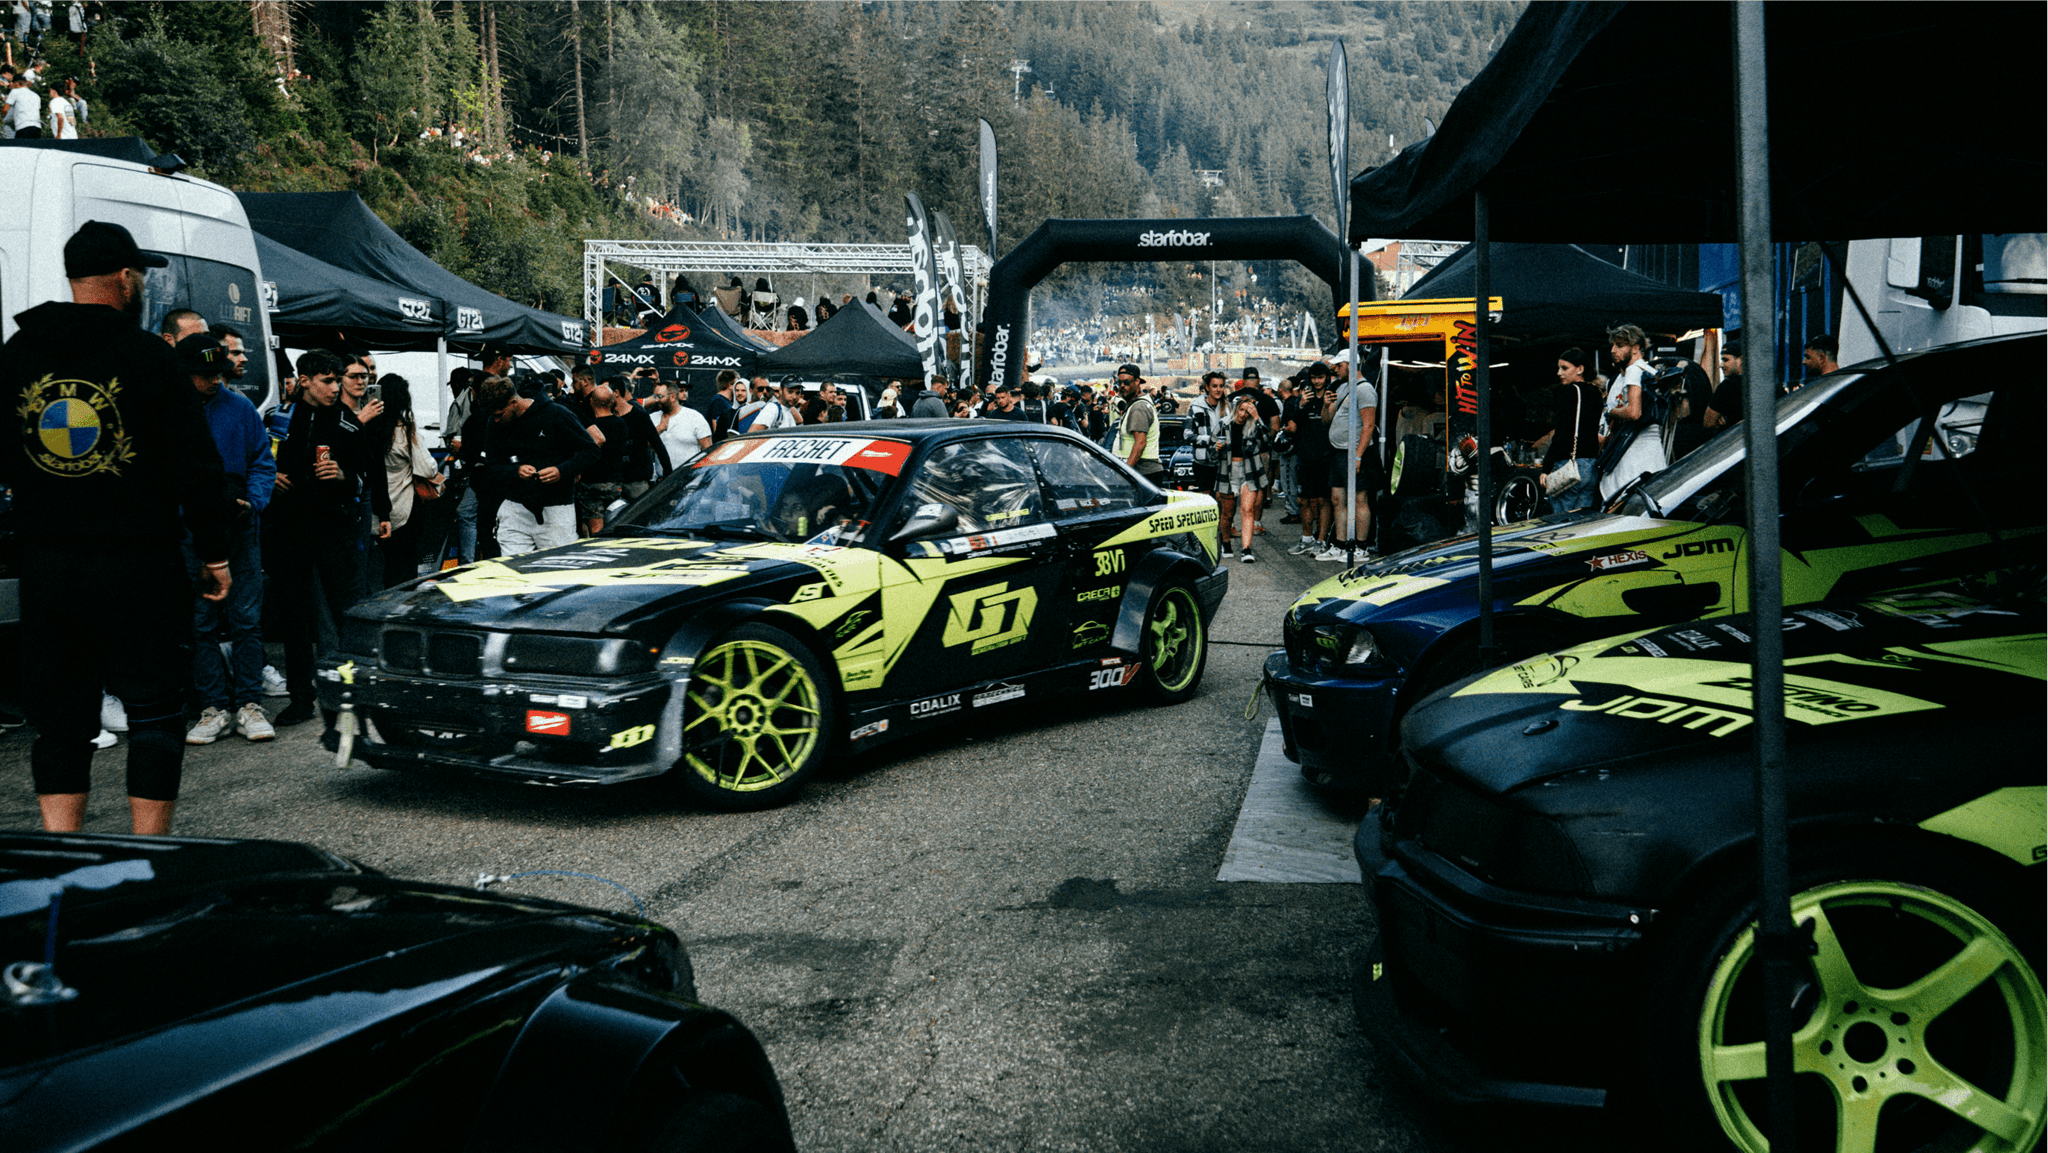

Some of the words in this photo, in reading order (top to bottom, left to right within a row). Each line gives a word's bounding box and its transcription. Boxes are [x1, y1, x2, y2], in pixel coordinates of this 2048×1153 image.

[604, 353, 655, 364] 24MX
[690, 355, 742, 367] 24MX
[763, 439, 851, 461] FRECHET
[1149, 516, 1175, 534] SPEED
[1608, 550, 1648, 566] HEXIS
[1663, 538, 1735, 560] JDM
[1088, 661, 1142, 691] 300V
[910, 693, 962, 715] COALIX
[1559, 695, 1754, 738] JDM
